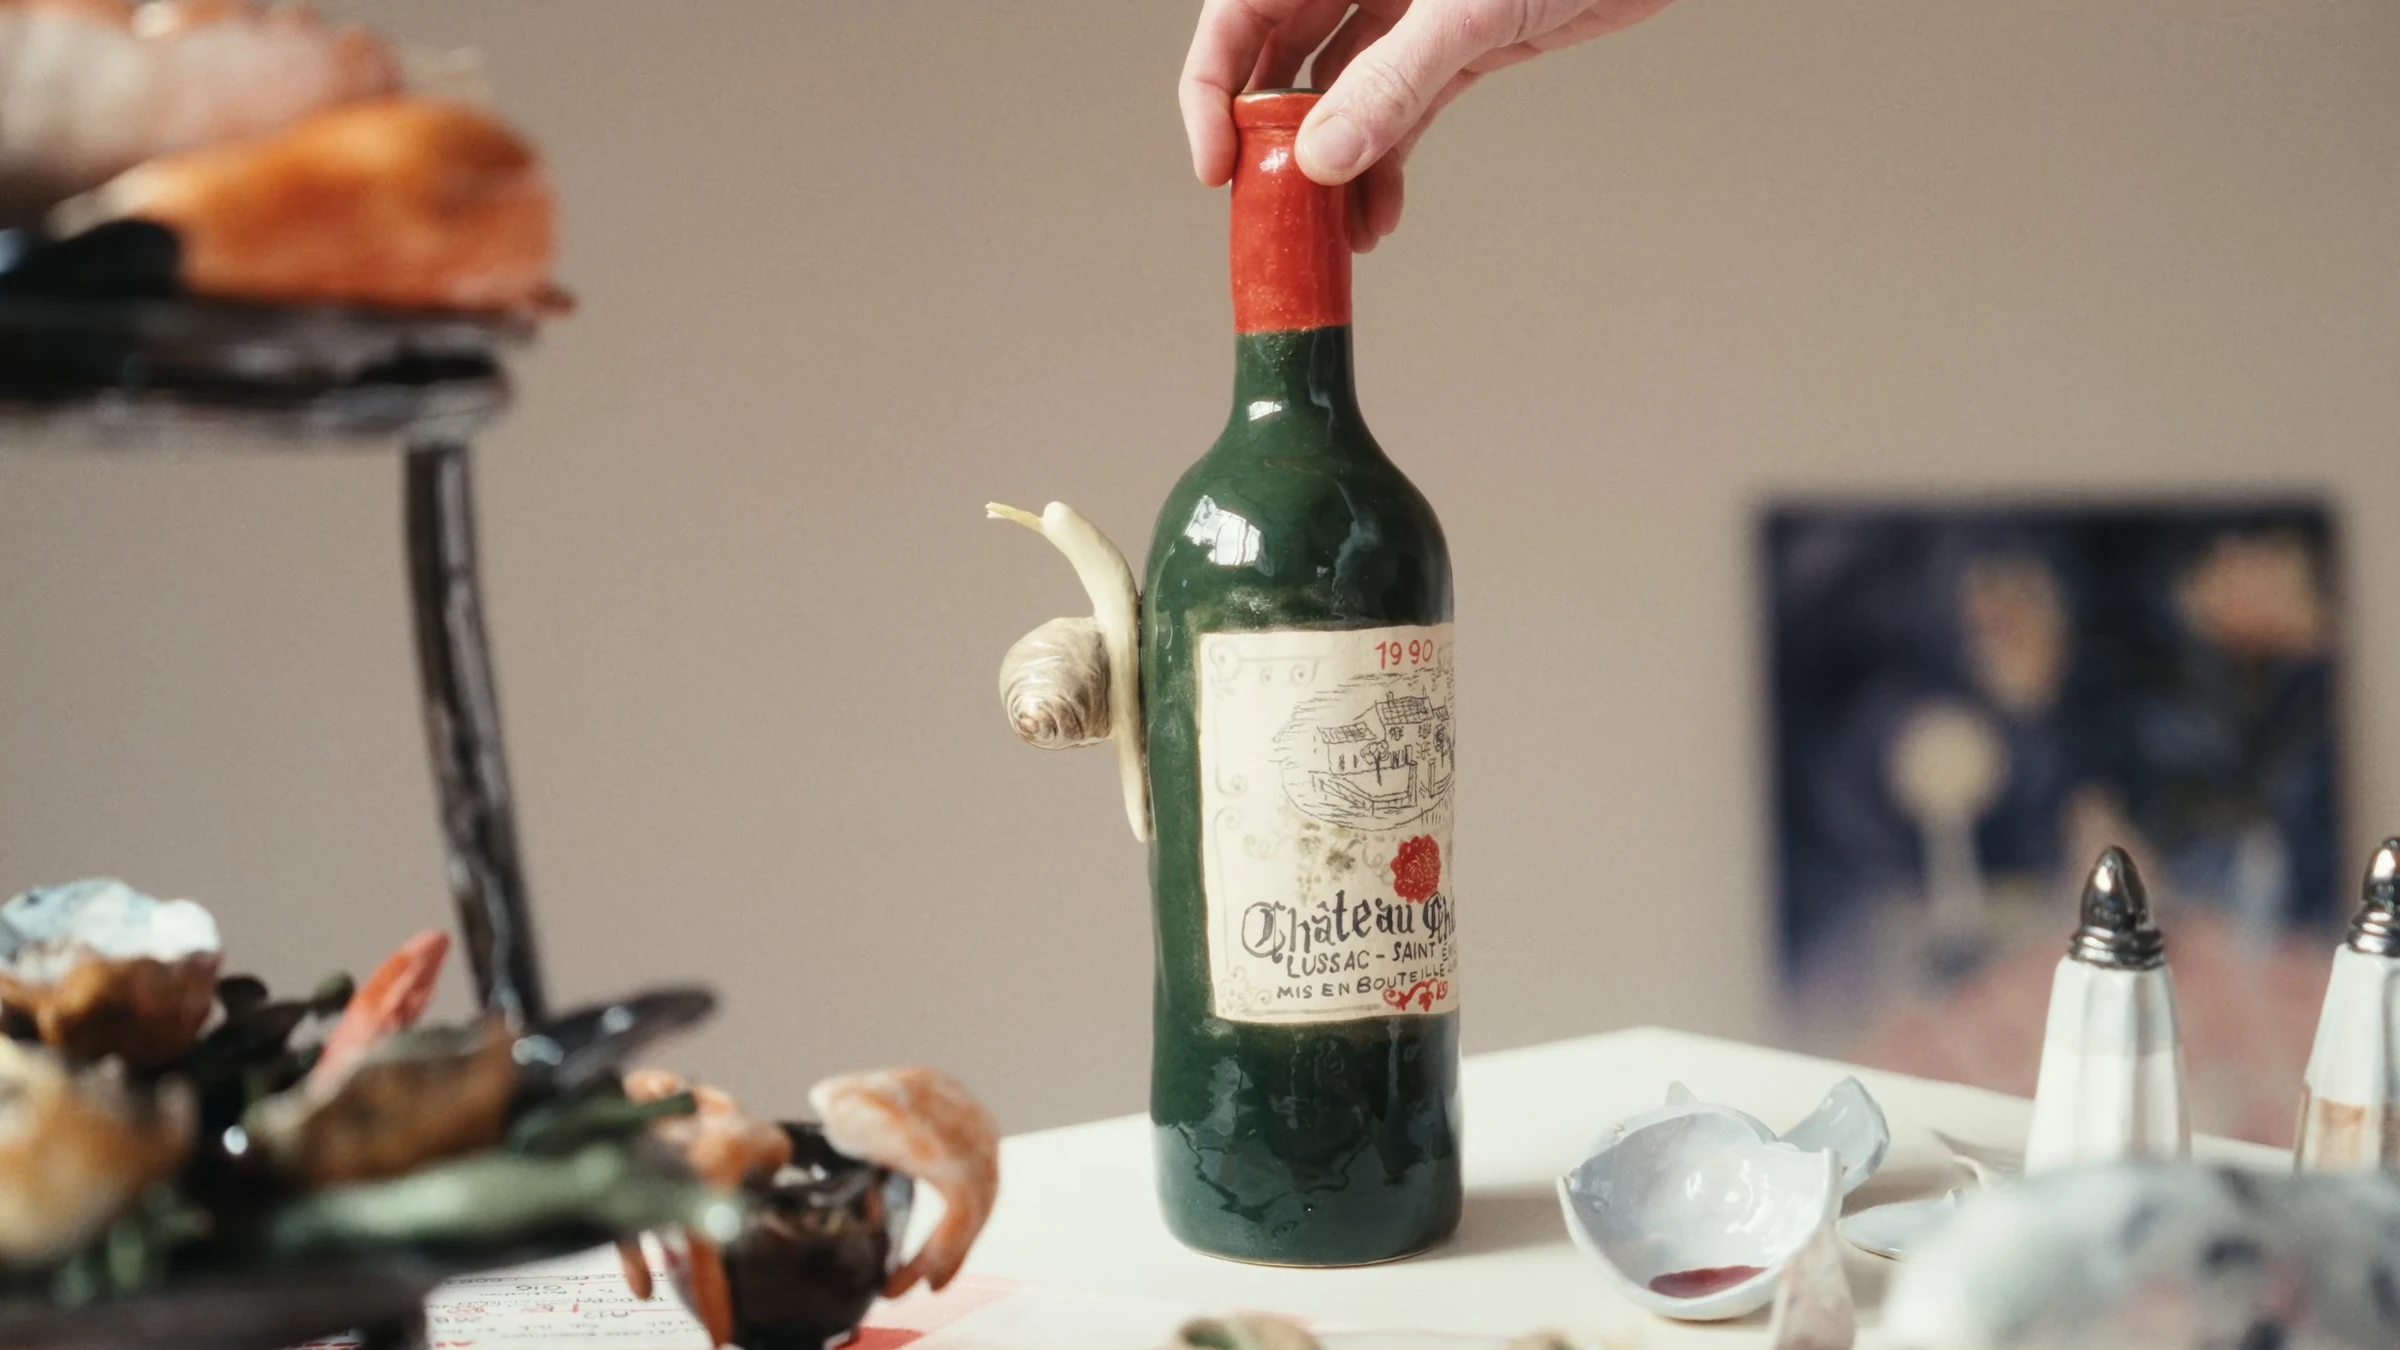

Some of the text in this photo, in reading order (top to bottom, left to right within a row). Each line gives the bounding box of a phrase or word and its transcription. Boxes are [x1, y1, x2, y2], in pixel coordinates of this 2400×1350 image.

[1375, 638, 1434, 670] 1990
[1241, 889, 1414, 964] Château
[1286, 950, 1370, 979] LUSSAC
[1392, 941, 1436, 963] SAINT
[1277, 985, 1313, 999] MIS
[1321, 983, 1350, 997] EN
[1356, 963, 1445, 993] BOUTEILLE
